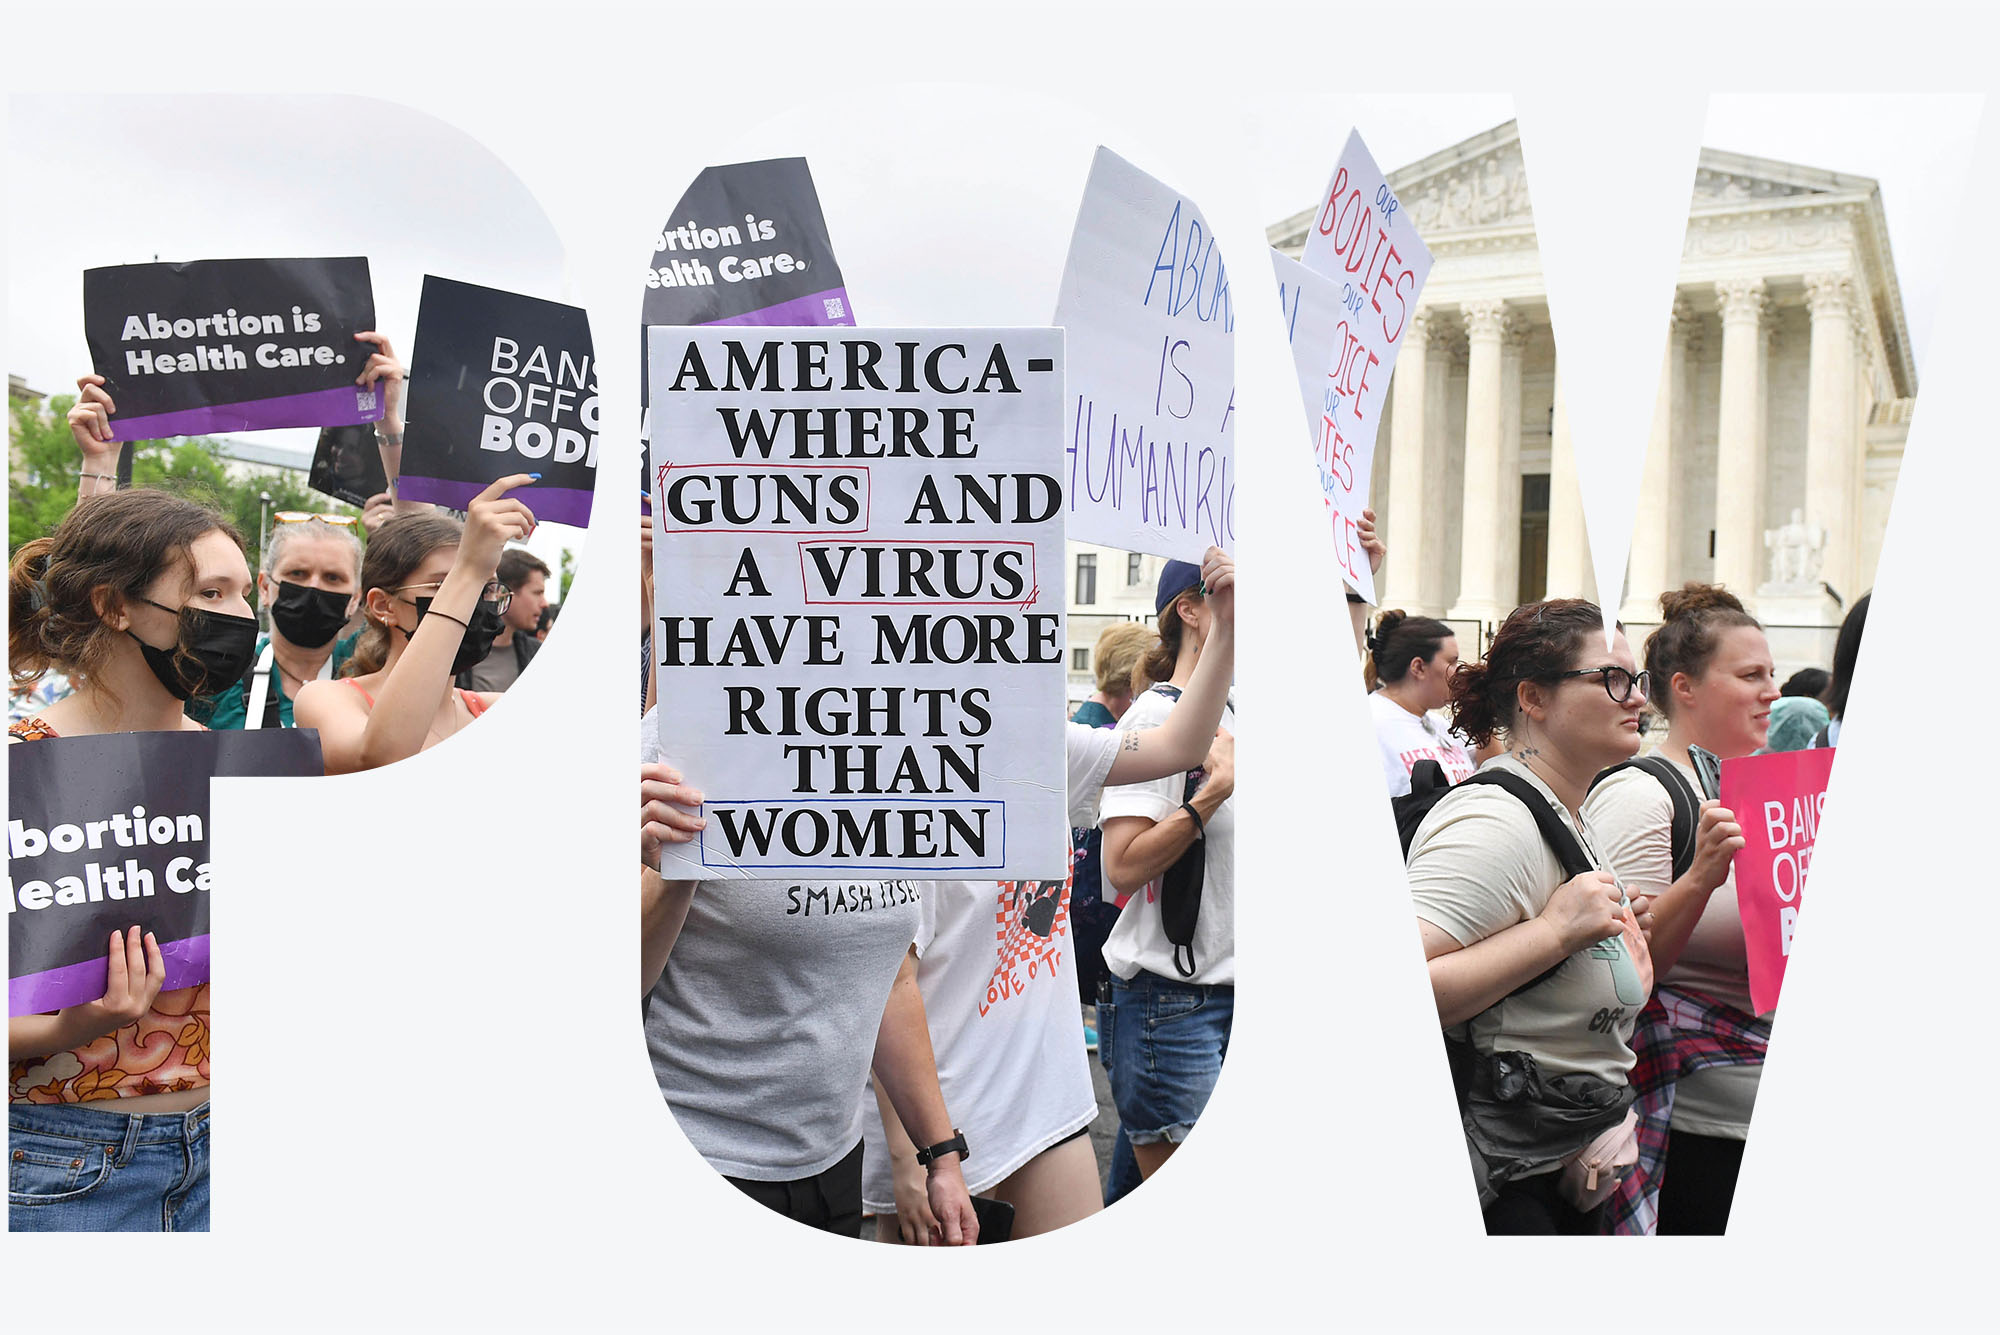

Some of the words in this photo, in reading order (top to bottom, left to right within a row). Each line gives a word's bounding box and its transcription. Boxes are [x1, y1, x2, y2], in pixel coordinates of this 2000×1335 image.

[745, 214, 776, 242] is
[1376, 184, 1398, 227] OUR
[718, 252, 806, 283] Care.
[1319, 167, 1414, 343] BODIES
[121, 308, 285, 341] Abortion
[291, 305, 322, 333] is
[125, 344, 248, 376] Health
[255, 343, 346, 369] Care.
[669, 340, 1053, 395] AMERICA-
[1156, 335, 1194, 419] IS
[483, 376, 577, 424] OFF
[716, 407, 979, 459] WHERE
[1066, 394, 1188, 529] HUMAN
[667, 474, 860, 525] GUNS
[904, 473, 1063, 524] AND
[723, 547, 773, 597] A
[805, 546, 1025, 599] VIRUS
[659, 615, 844, 667] HAVE
[870, 614, 1063, 665] MORE
[723, 686, 992, 737] RIGHTS
[783, 743, 985, 794] THAN
[712, 807, 991, 859] WOMEN
[786, 884, 873, 917] SMASH
[978, 972, 1025, 1018] LOVE
